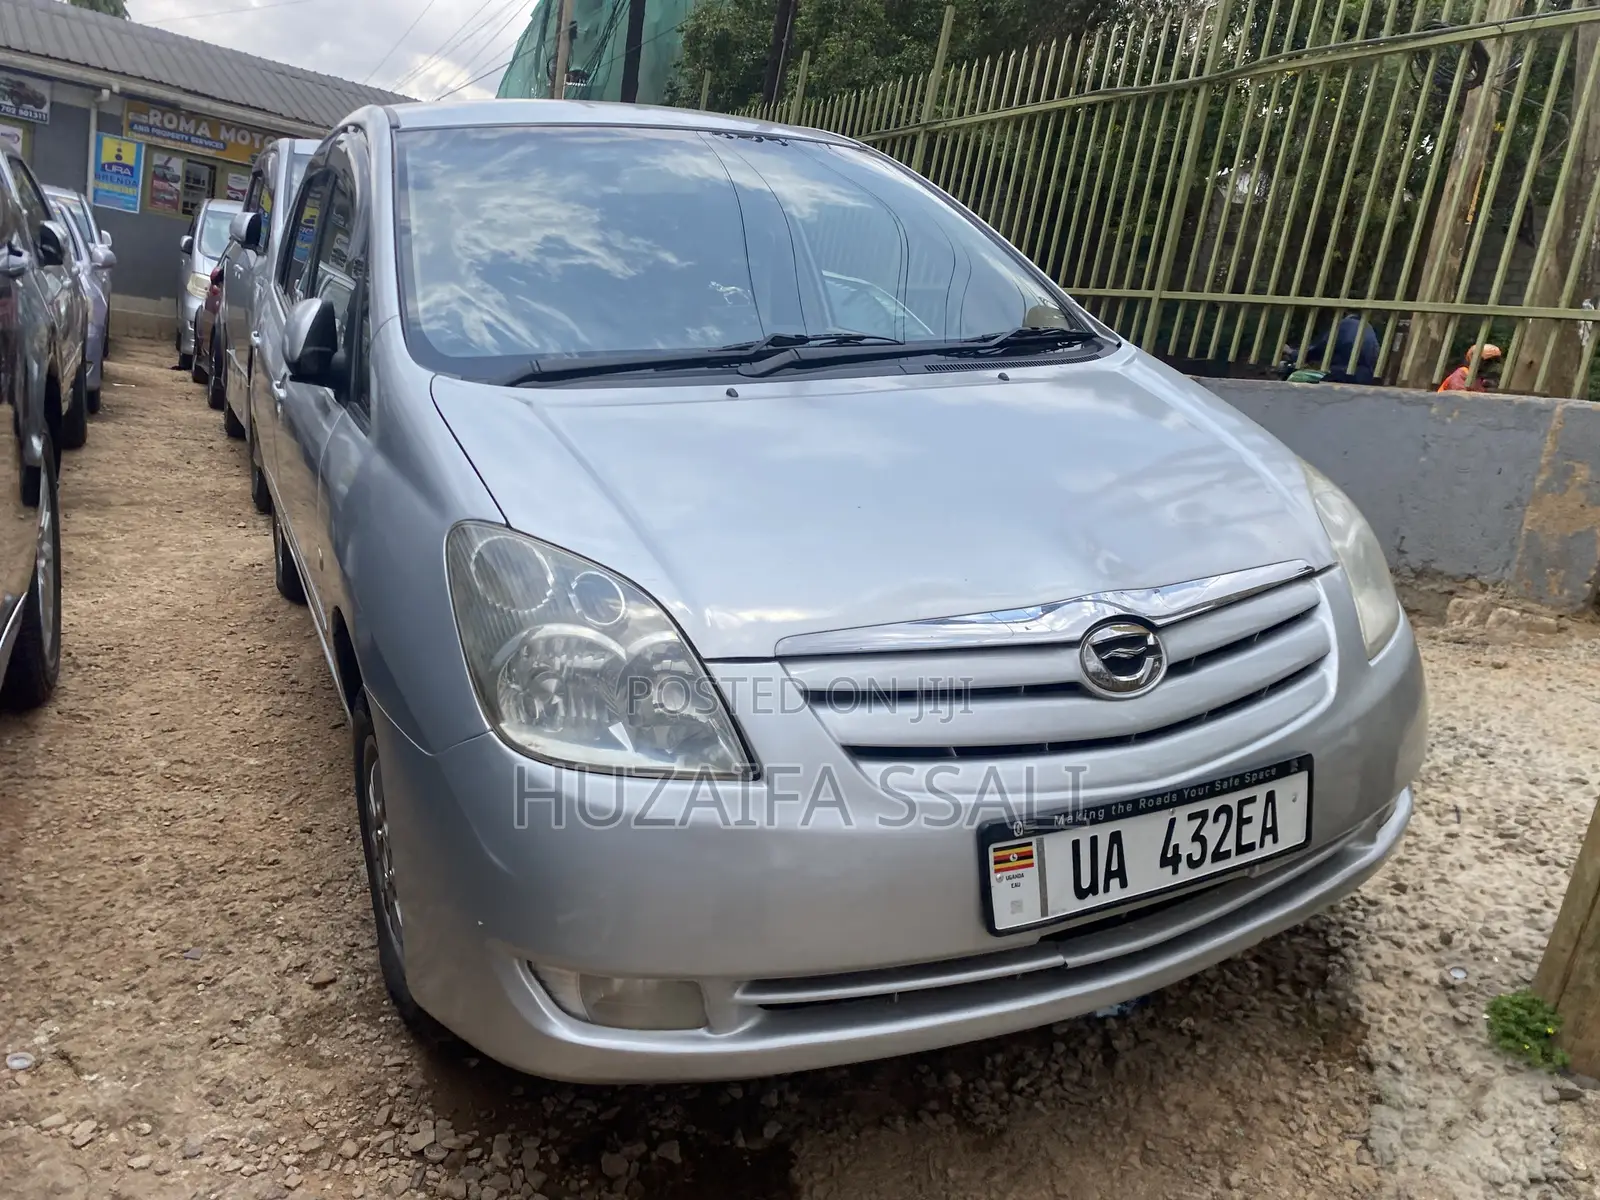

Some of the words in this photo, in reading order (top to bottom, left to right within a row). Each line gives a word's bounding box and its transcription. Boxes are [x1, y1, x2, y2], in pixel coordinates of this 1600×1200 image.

[148, 109, 212, 138] ROMA
[151, 127, 189, 142] PROPERTY
[190, 136, 225, 150] SERVICES
[1054, 808, 1105, 828] Making
[1111, 804, 1133, 816] the
[1138, 791, 1178, 810] Roads
[1183, 784, 1211, 799] Your
[1214, 776, 1240, 792] Safe
[1244, 766, 1277, 785] Space
[1072, 830, 1129, 900] UA
[1159, 789, 1279, 876] 432EA
[1005, 872, 1025, 882] UGANDA
